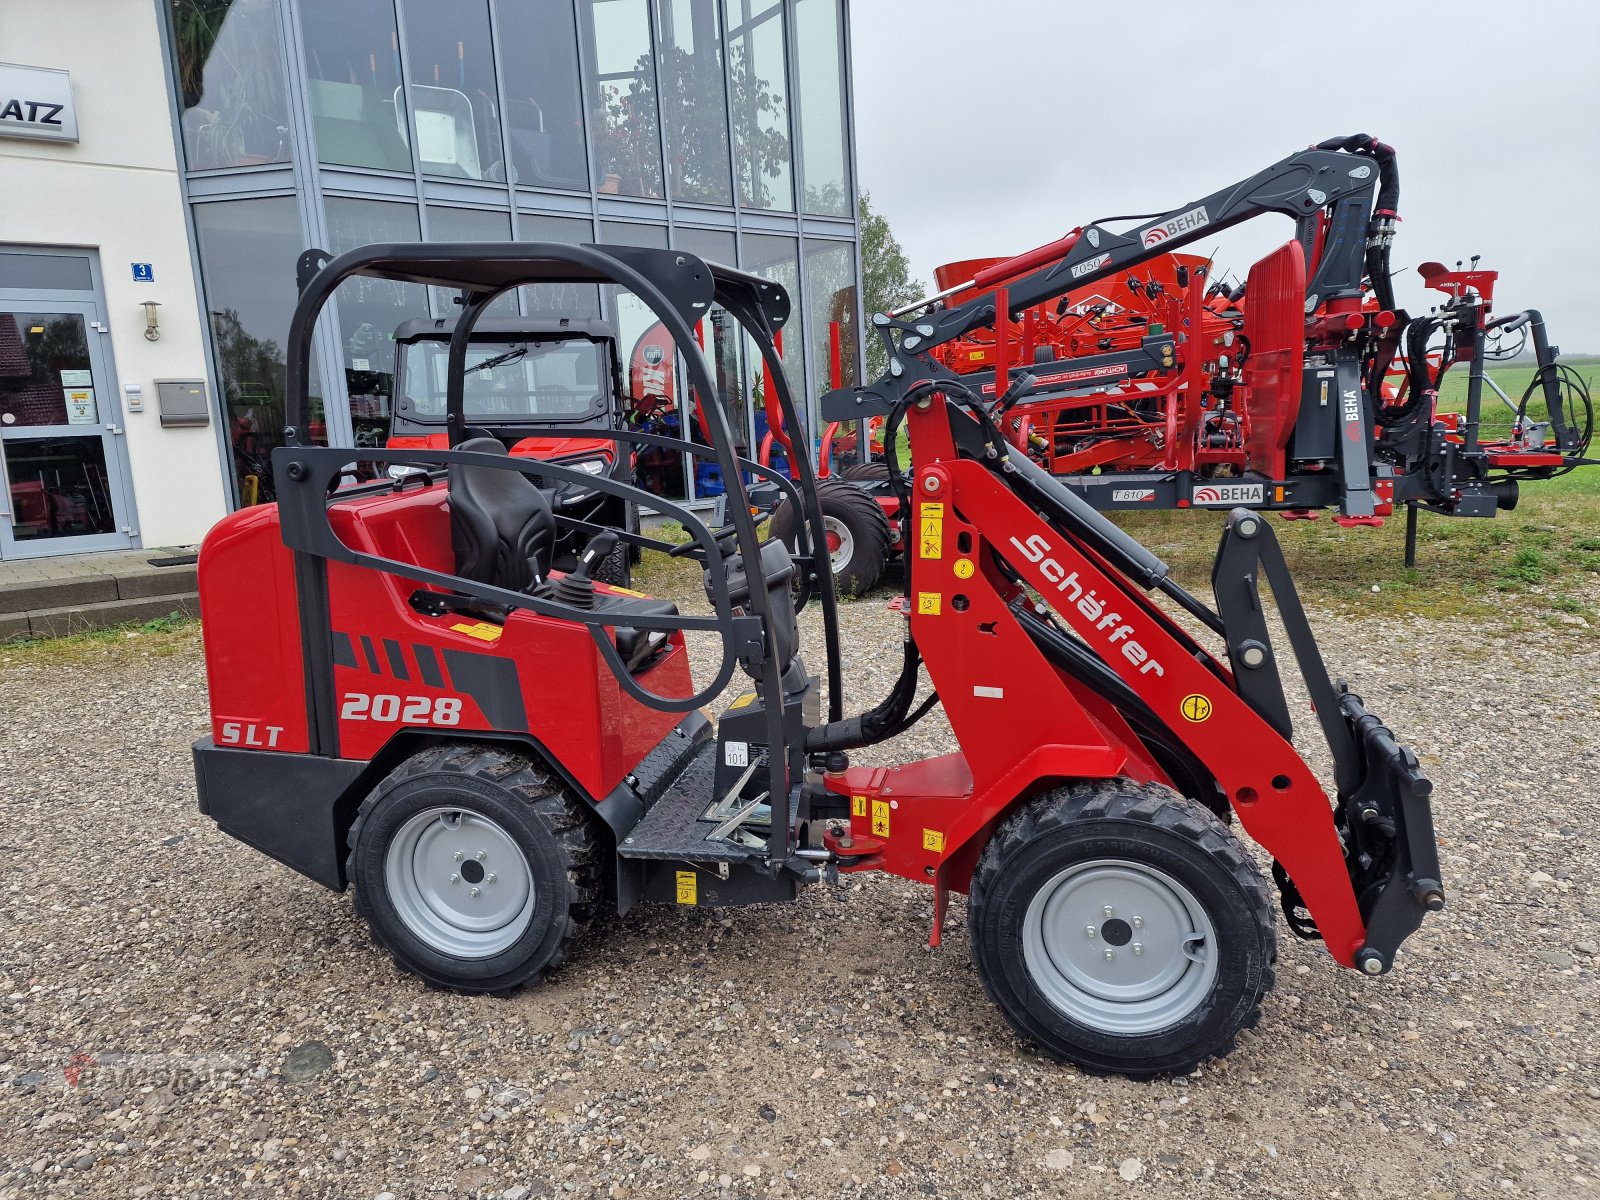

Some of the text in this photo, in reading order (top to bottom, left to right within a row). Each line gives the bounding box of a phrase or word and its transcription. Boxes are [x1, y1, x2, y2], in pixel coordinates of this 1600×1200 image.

[0, 99, 64, 125] ATZ
[1167, 211, 1207, 236] BEHA
[138, 265, 146, 276] 3
[1072, 258, 1100, 276] 7050
[1344, 390, 1359, 421] BEHA
[1115, 491, 1144, 500] T 810
[1221, 487, 1261, 500] BEHA
[1009, 534, 1164, 677] Schäffer
[341, 693, 463, 725] 2028
[222, 722, 284, 747] SLT
[727, 753, 741, 764] 101
